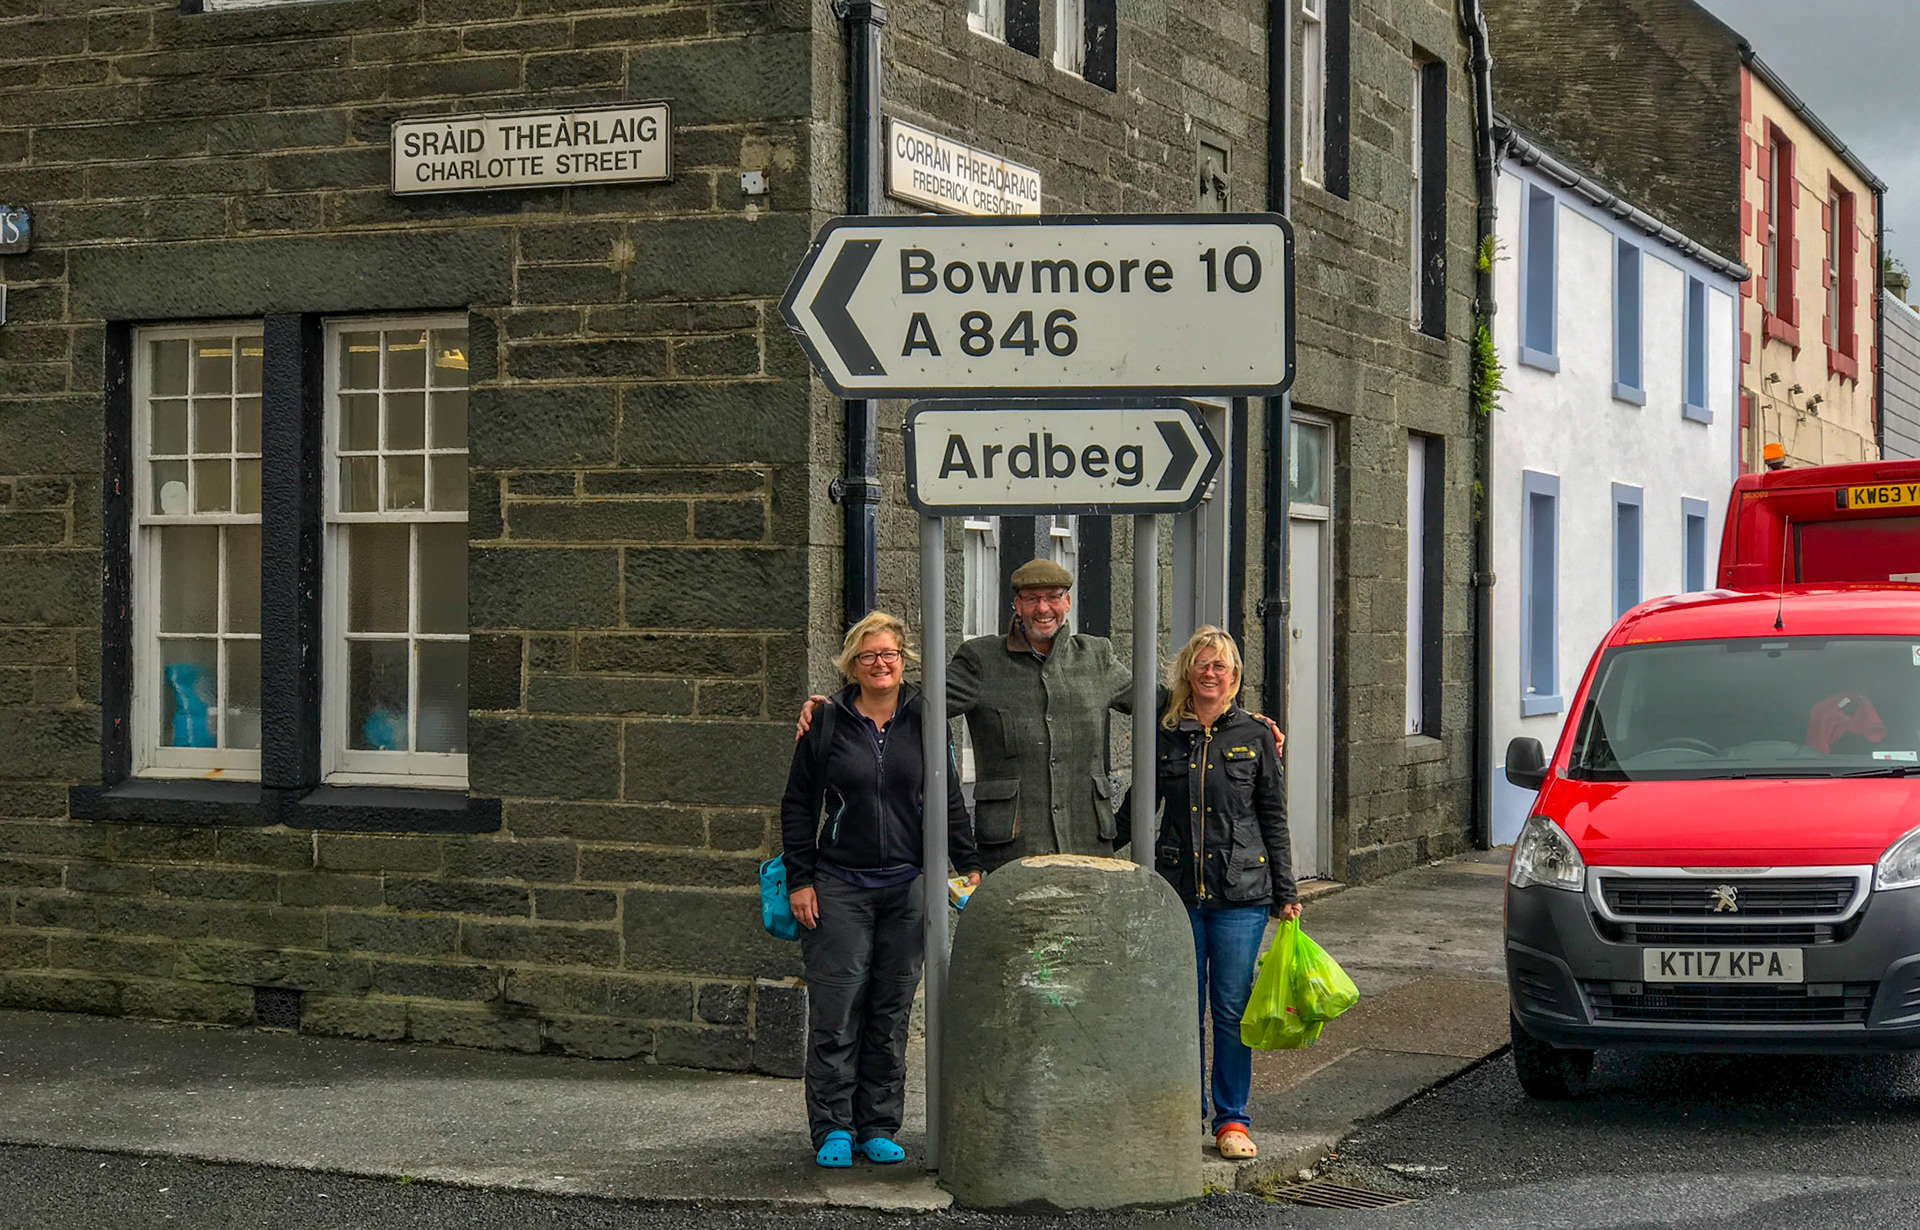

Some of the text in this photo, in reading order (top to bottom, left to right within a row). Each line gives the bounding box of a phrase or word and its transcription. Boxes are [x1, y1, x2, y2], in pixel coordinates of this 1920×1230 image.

[403, 115, 657, 158] SRÀID THEÀRLAIG
[415, 149, 642, 183] CHARLOTTE STREET
[896, 133, 1038, 202] CORRAN FHREADARAIG
[913, 169, 969, 205] FREDERICK
[900, 245, 1262, 294] Bowmore 10
[938, 432, 1144, 487] Ardbeg
[1854, 485, 1920, 505] KW63 Y
[1660, 951, 1784, 977] KT17 KPA
